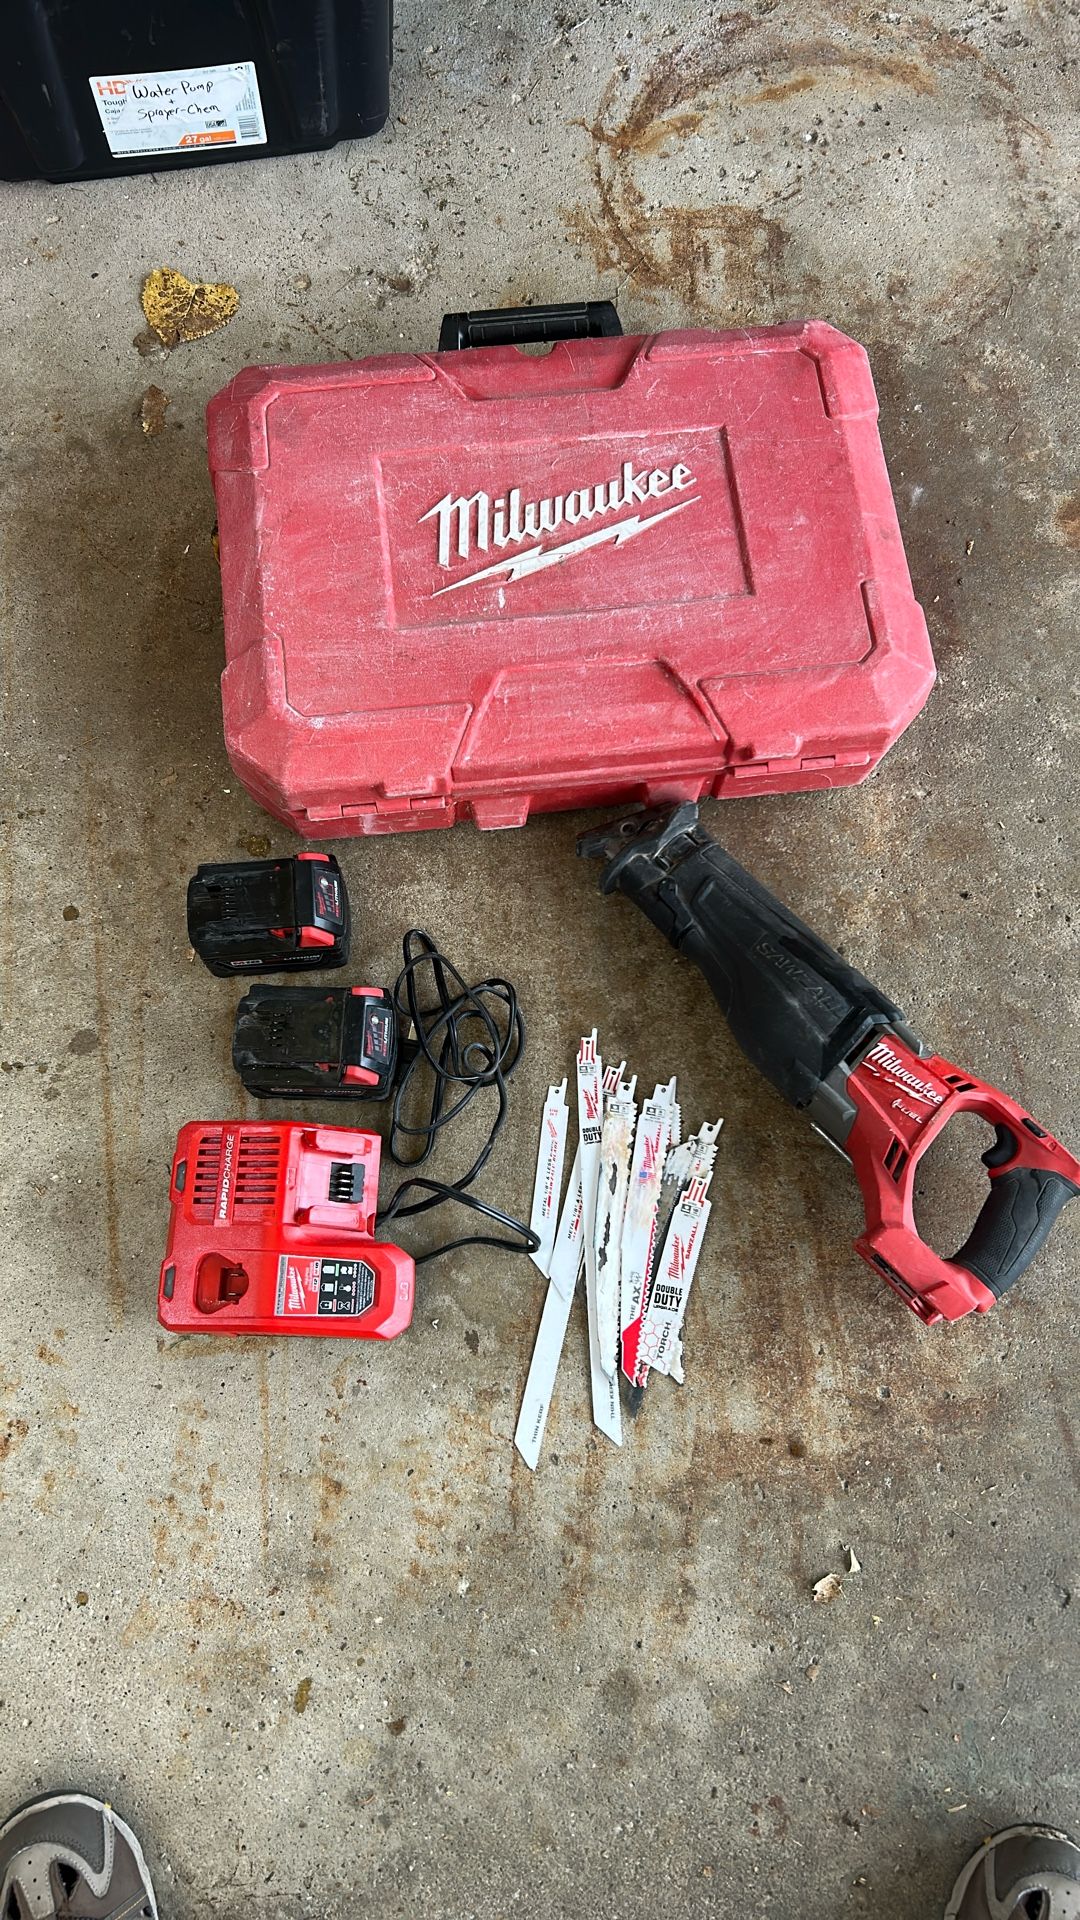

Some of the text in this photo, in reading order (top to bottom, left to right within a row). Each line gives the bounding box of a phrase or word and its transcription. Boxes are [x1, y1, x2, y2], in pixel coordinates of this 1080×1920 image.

[132, 80, 214, 99] Water Pump
[185, 135, 198, 144] 27
[199, 136, 212, 144] gal
[418, 462, 697, 569] Milwaukee
[866, 1042, 944, 1105] Milwaukee
[583, 1131, 603, 1143] DUTY
[685, 1224, 699, 1260] SAWZALL
[667, 1234, 681, 1280] Milwaukee
[287, 1265, 302, 1311] Milwaukee
[632, 1285, 640, 1305] AX
[656, 1284, 683, 1296] DOUBLE
[654, 1293, 682, 1308] DUTY
[656, 1322, 672, 1359] TORCH
[532, 1425, 540, 1443] THIN
